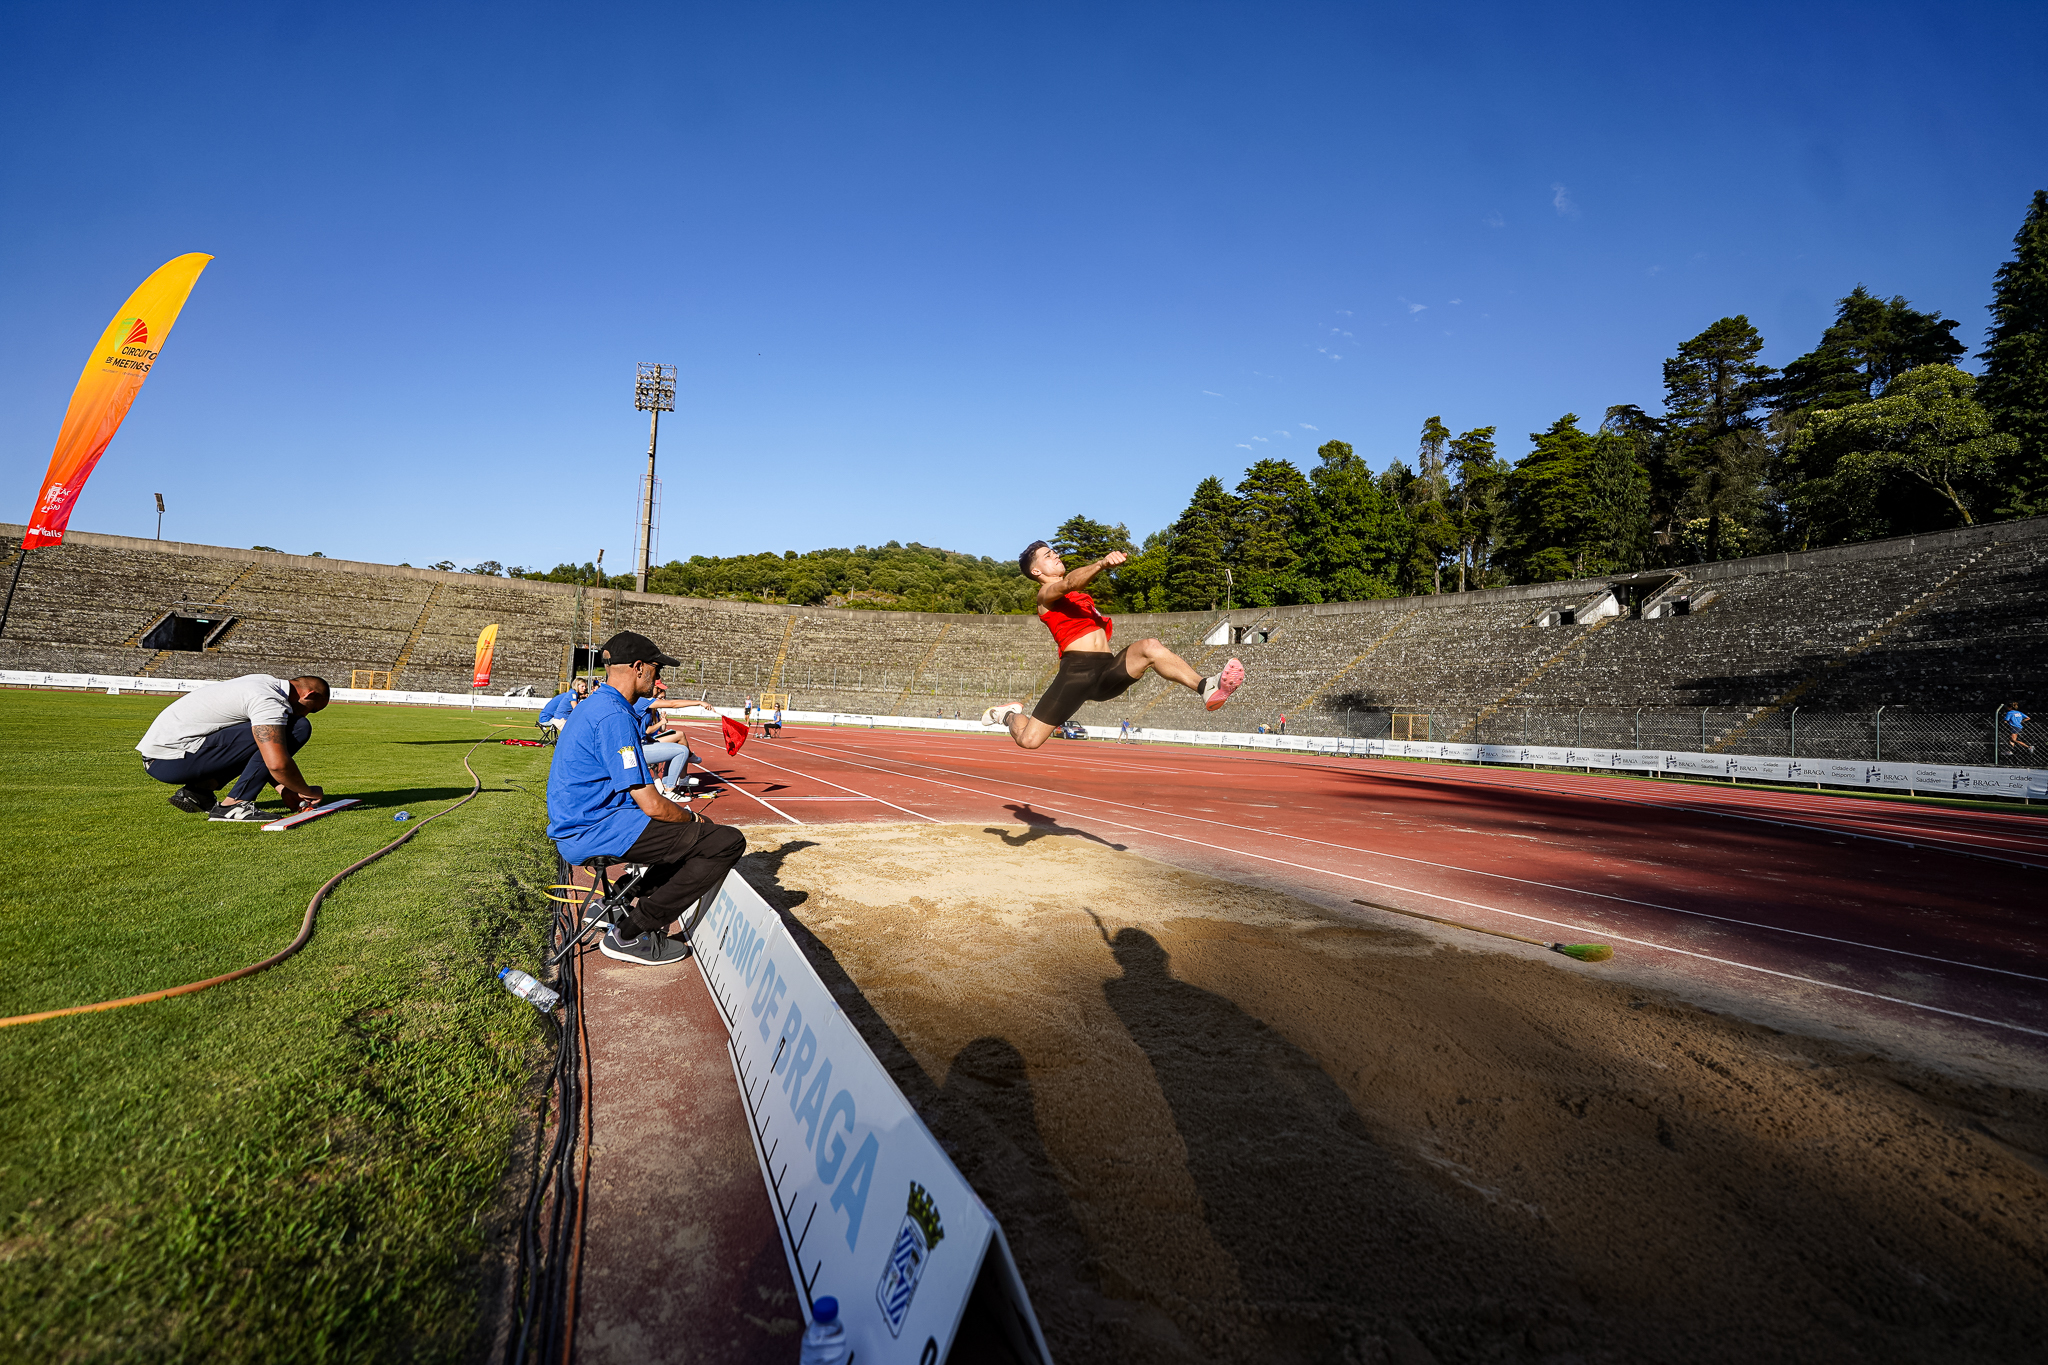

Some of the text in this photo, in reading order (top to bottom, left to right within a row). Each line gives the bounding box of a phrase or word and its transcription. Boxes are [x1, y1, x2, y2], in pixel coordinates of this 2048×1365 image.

[1831, 771, 1856, 779] Desporto
[705, 887, 880, 1255] ETISMO DE BRAGA
